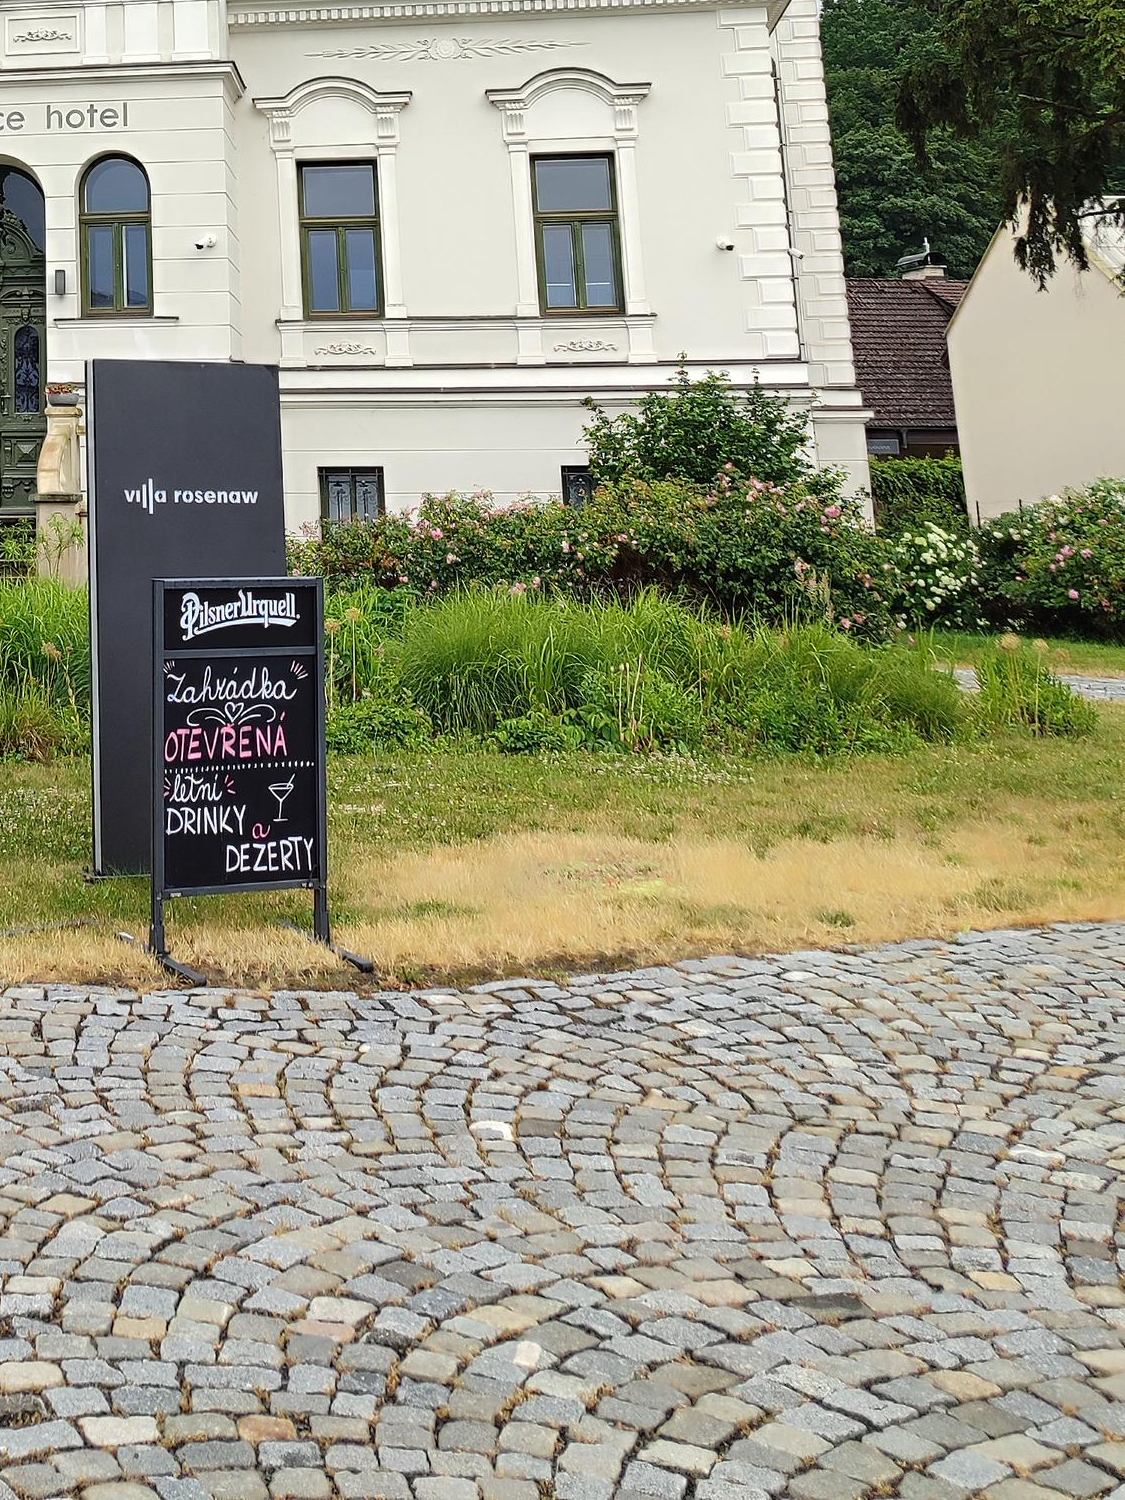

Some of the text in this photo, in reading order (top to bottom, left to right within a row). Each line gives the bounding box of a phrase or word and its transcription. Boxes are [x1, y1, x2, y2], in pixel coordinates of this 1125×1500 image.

[46, 102, 128, 129] hotel
[124, 478, 259, 514] villa rosenaw
[167, 665, 297, 703] Zahrádka
[164, 711, 288, 762] OTEVŘENÁ
[169, 773, 223, 802] letní
[166, 804, 271, 839] DRINKY a
[226, 836, 314, 872] DEZERTY
